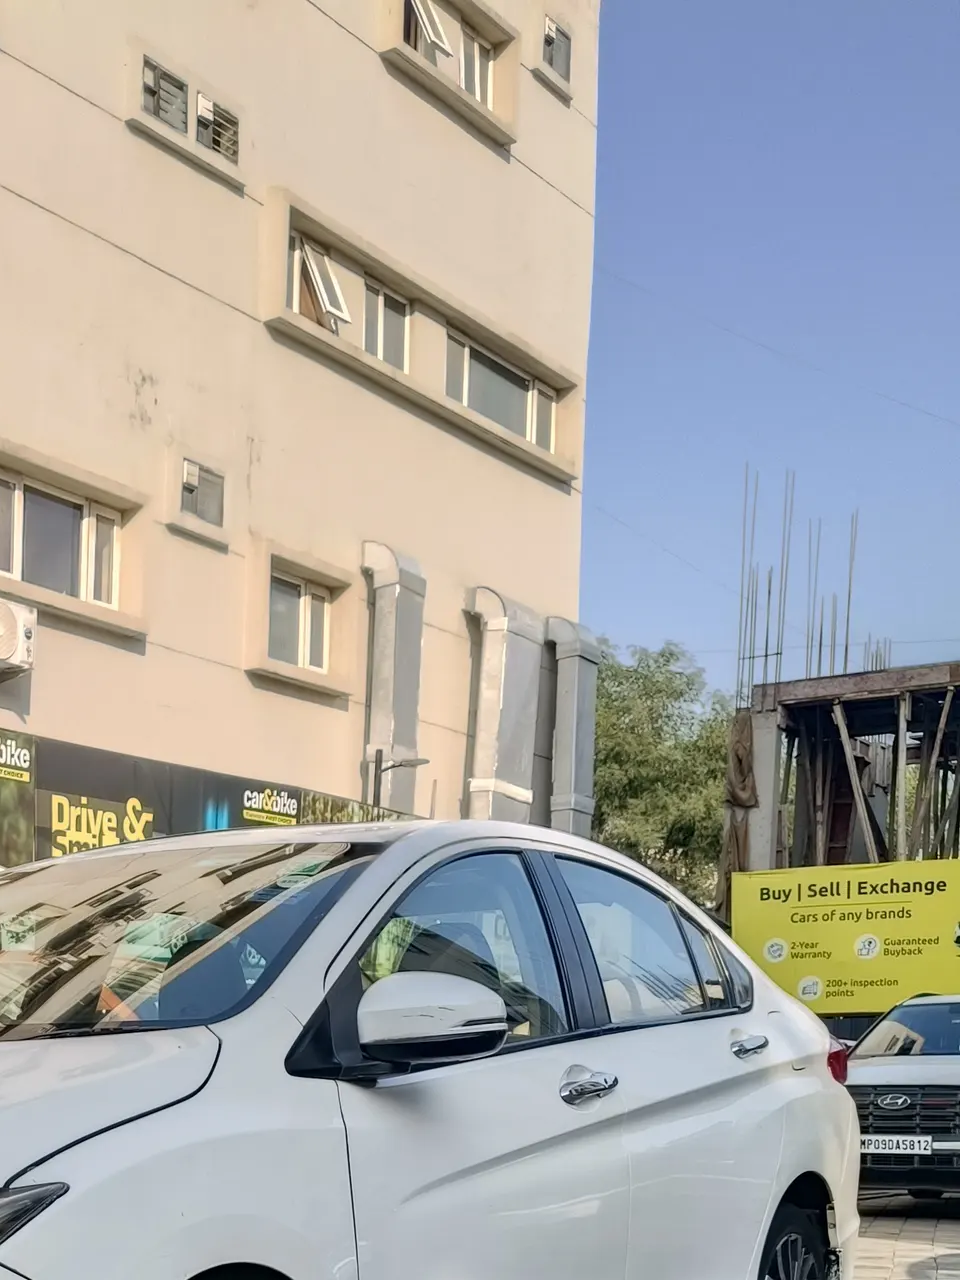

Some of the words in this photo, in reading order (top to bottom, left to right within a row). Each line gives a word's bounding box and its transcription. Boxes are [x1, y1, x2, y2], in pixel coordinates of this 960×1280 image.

[3, 769, 24, 779] CHOICE
[244, 789, 297, 816] car&bike
[52, 795, 117, 838] Drive
[123, 797, 154, 841] &
[759, 887, 792, 903] Buy
[807, 882, 841, 898] Sell
[857, 879, 947, 896] Exchange
[790, 912, 818, 924] Cars
[822, 909, 836, 922] of
[839, 911, 862, 923] any
[866, 907, 912, 920] brands
[790, 941, 819, 950] 2-Year
[883, 936, 940, 946] Guaranteed
[790, 950, 832, 960] Warranty
[883, 947, 923, 958] Buyback
[825, 979, 848, 989] 200+
[850, 977, 899, 990] inspection
[825, 988, 855, 1000] points
[860, 1139, 929, 1151] MP09DA5812
